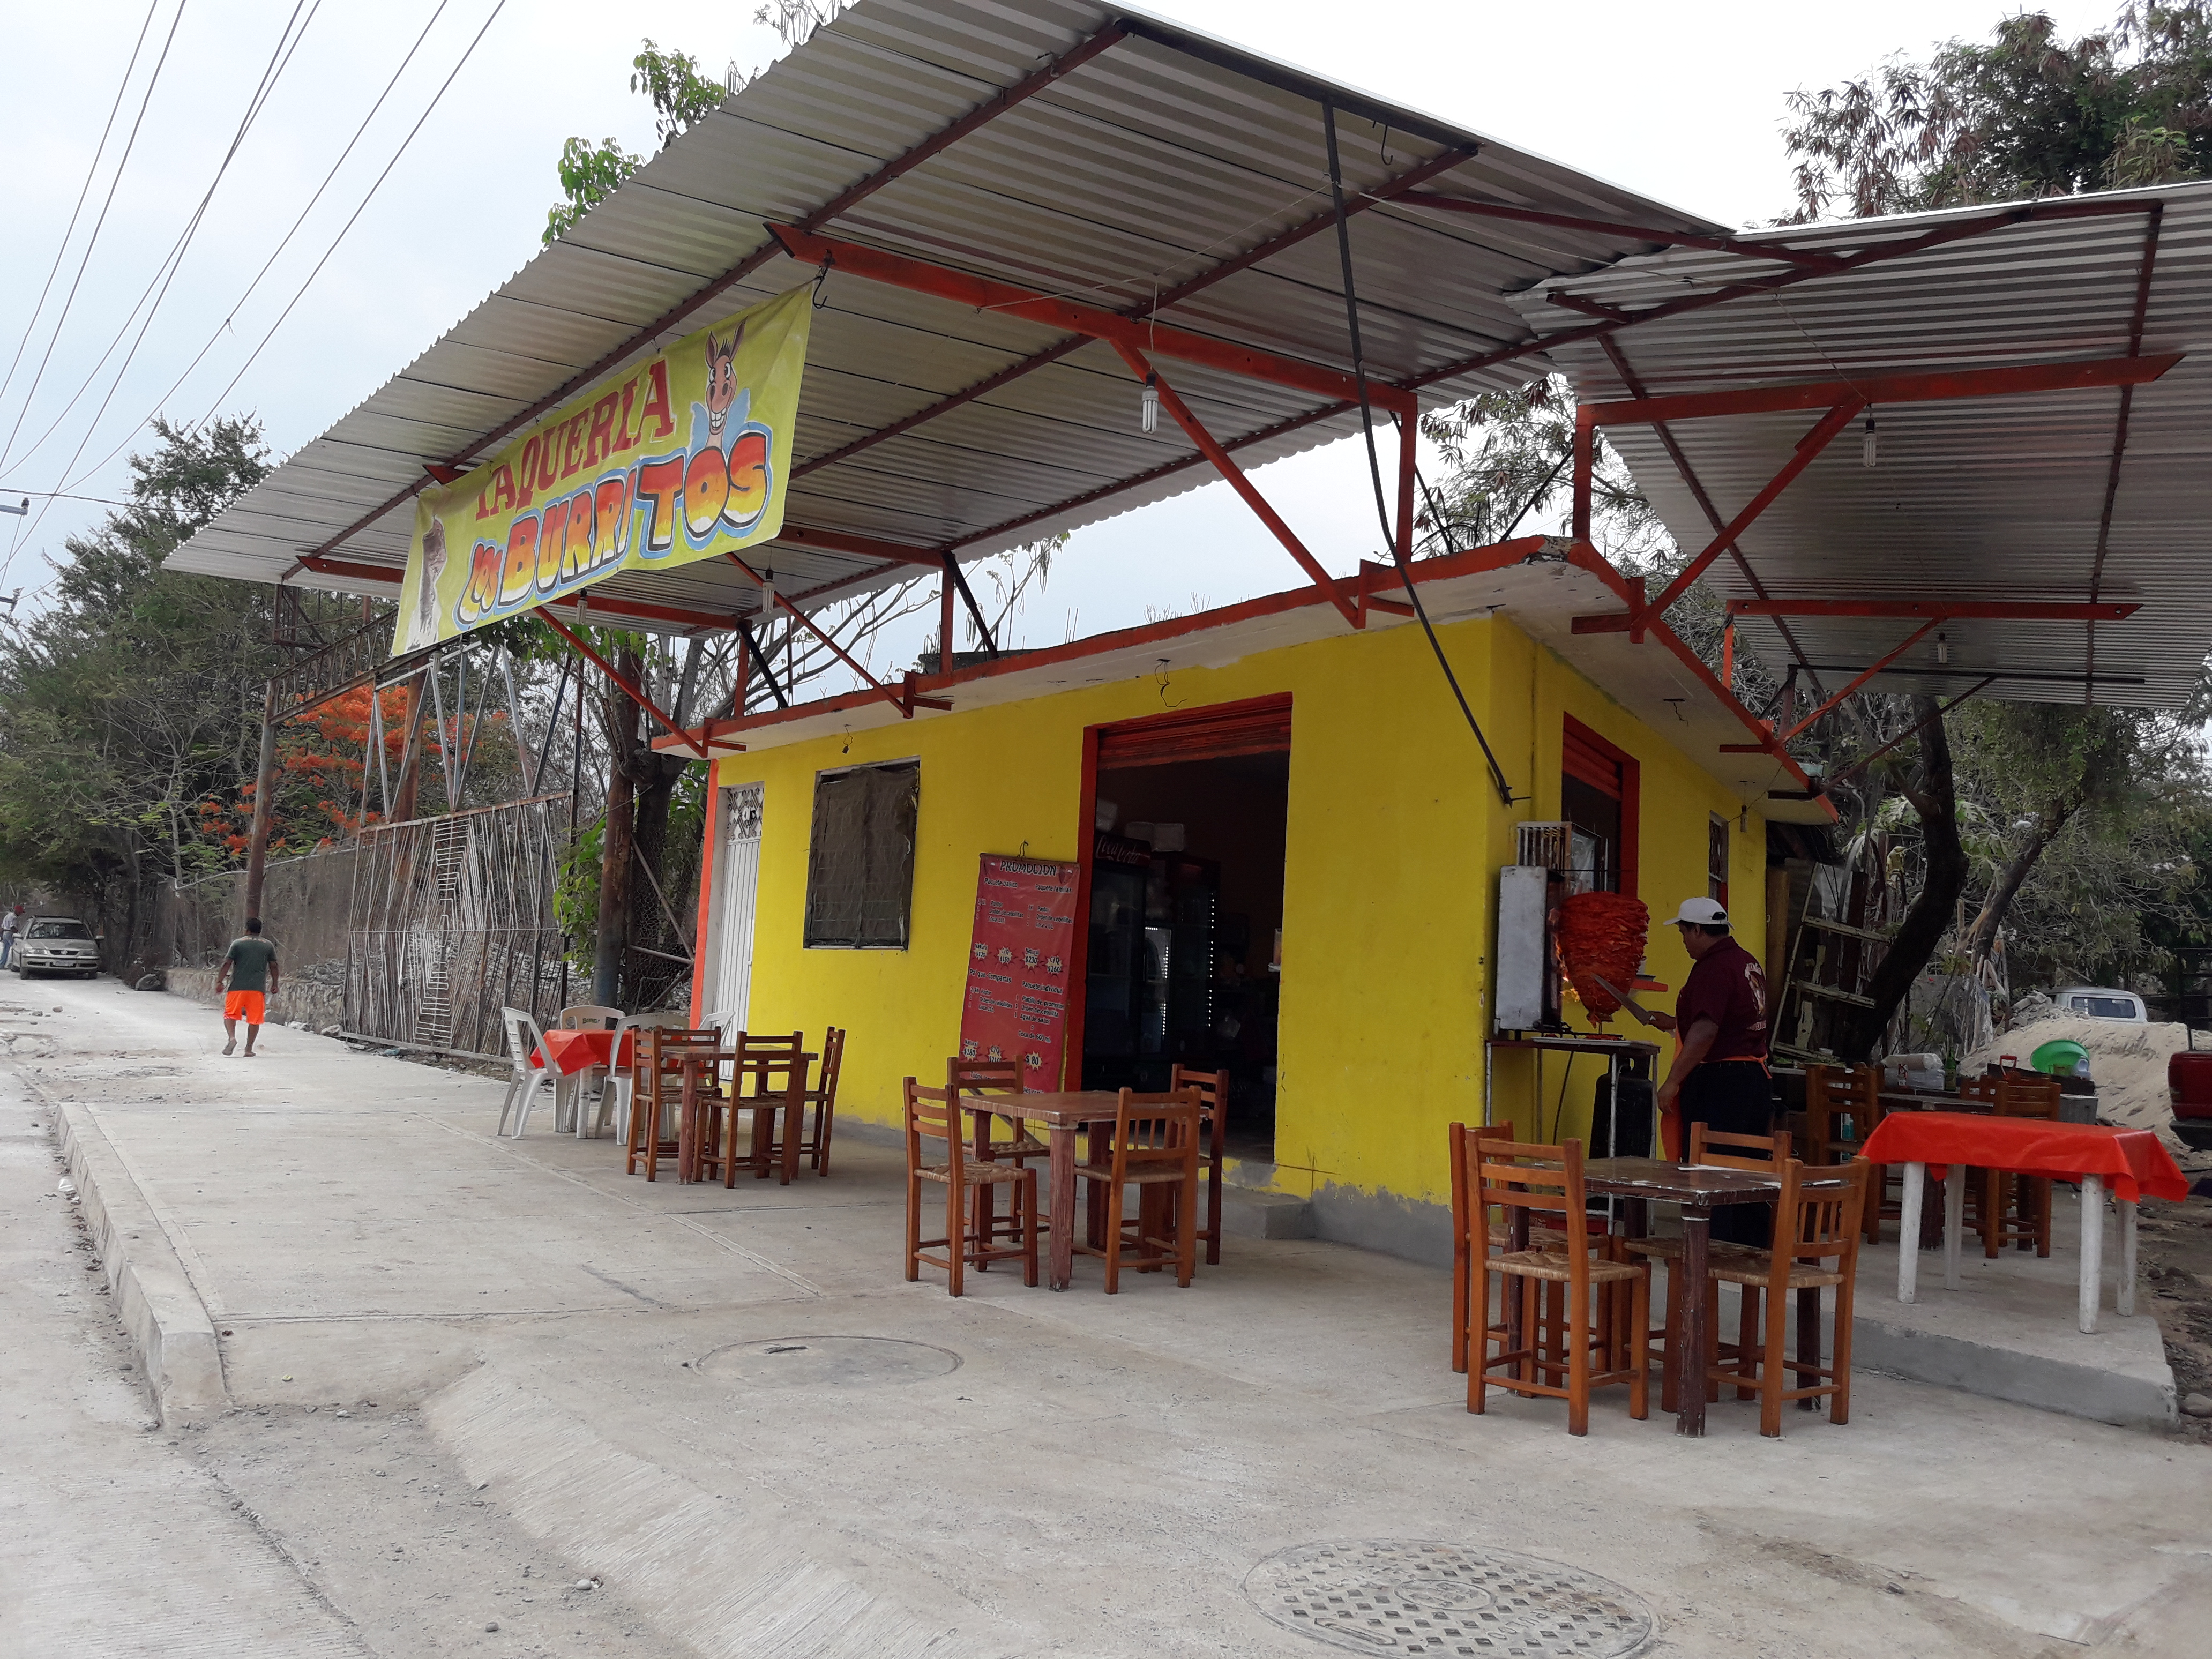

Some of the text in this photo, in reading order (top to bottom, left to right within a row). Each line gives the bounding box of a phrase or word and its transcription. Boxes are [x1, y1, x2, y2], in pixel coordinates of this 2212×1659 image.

[475, 360, 676, 521] TAQUERIA
[498, 431, 769, 607] BURRITOS
[999, 860, 1057, 876] PROMOCION
[1025, 955, 1037, 964] $230
[1050, 956, 1060, 965] C/Q
[1047, 965, 1060, 973] $260
[1021, 980, 1041, 991] Paquete
[1018, 1029, 1029, 1038] Coca
[1029, 1032, 1036, 1040] de
[963, 1048, 976, 1057] $180
[990, 1045, 1000, 1056] C/Q
[1031, 1055, 1040, 1065] 80
